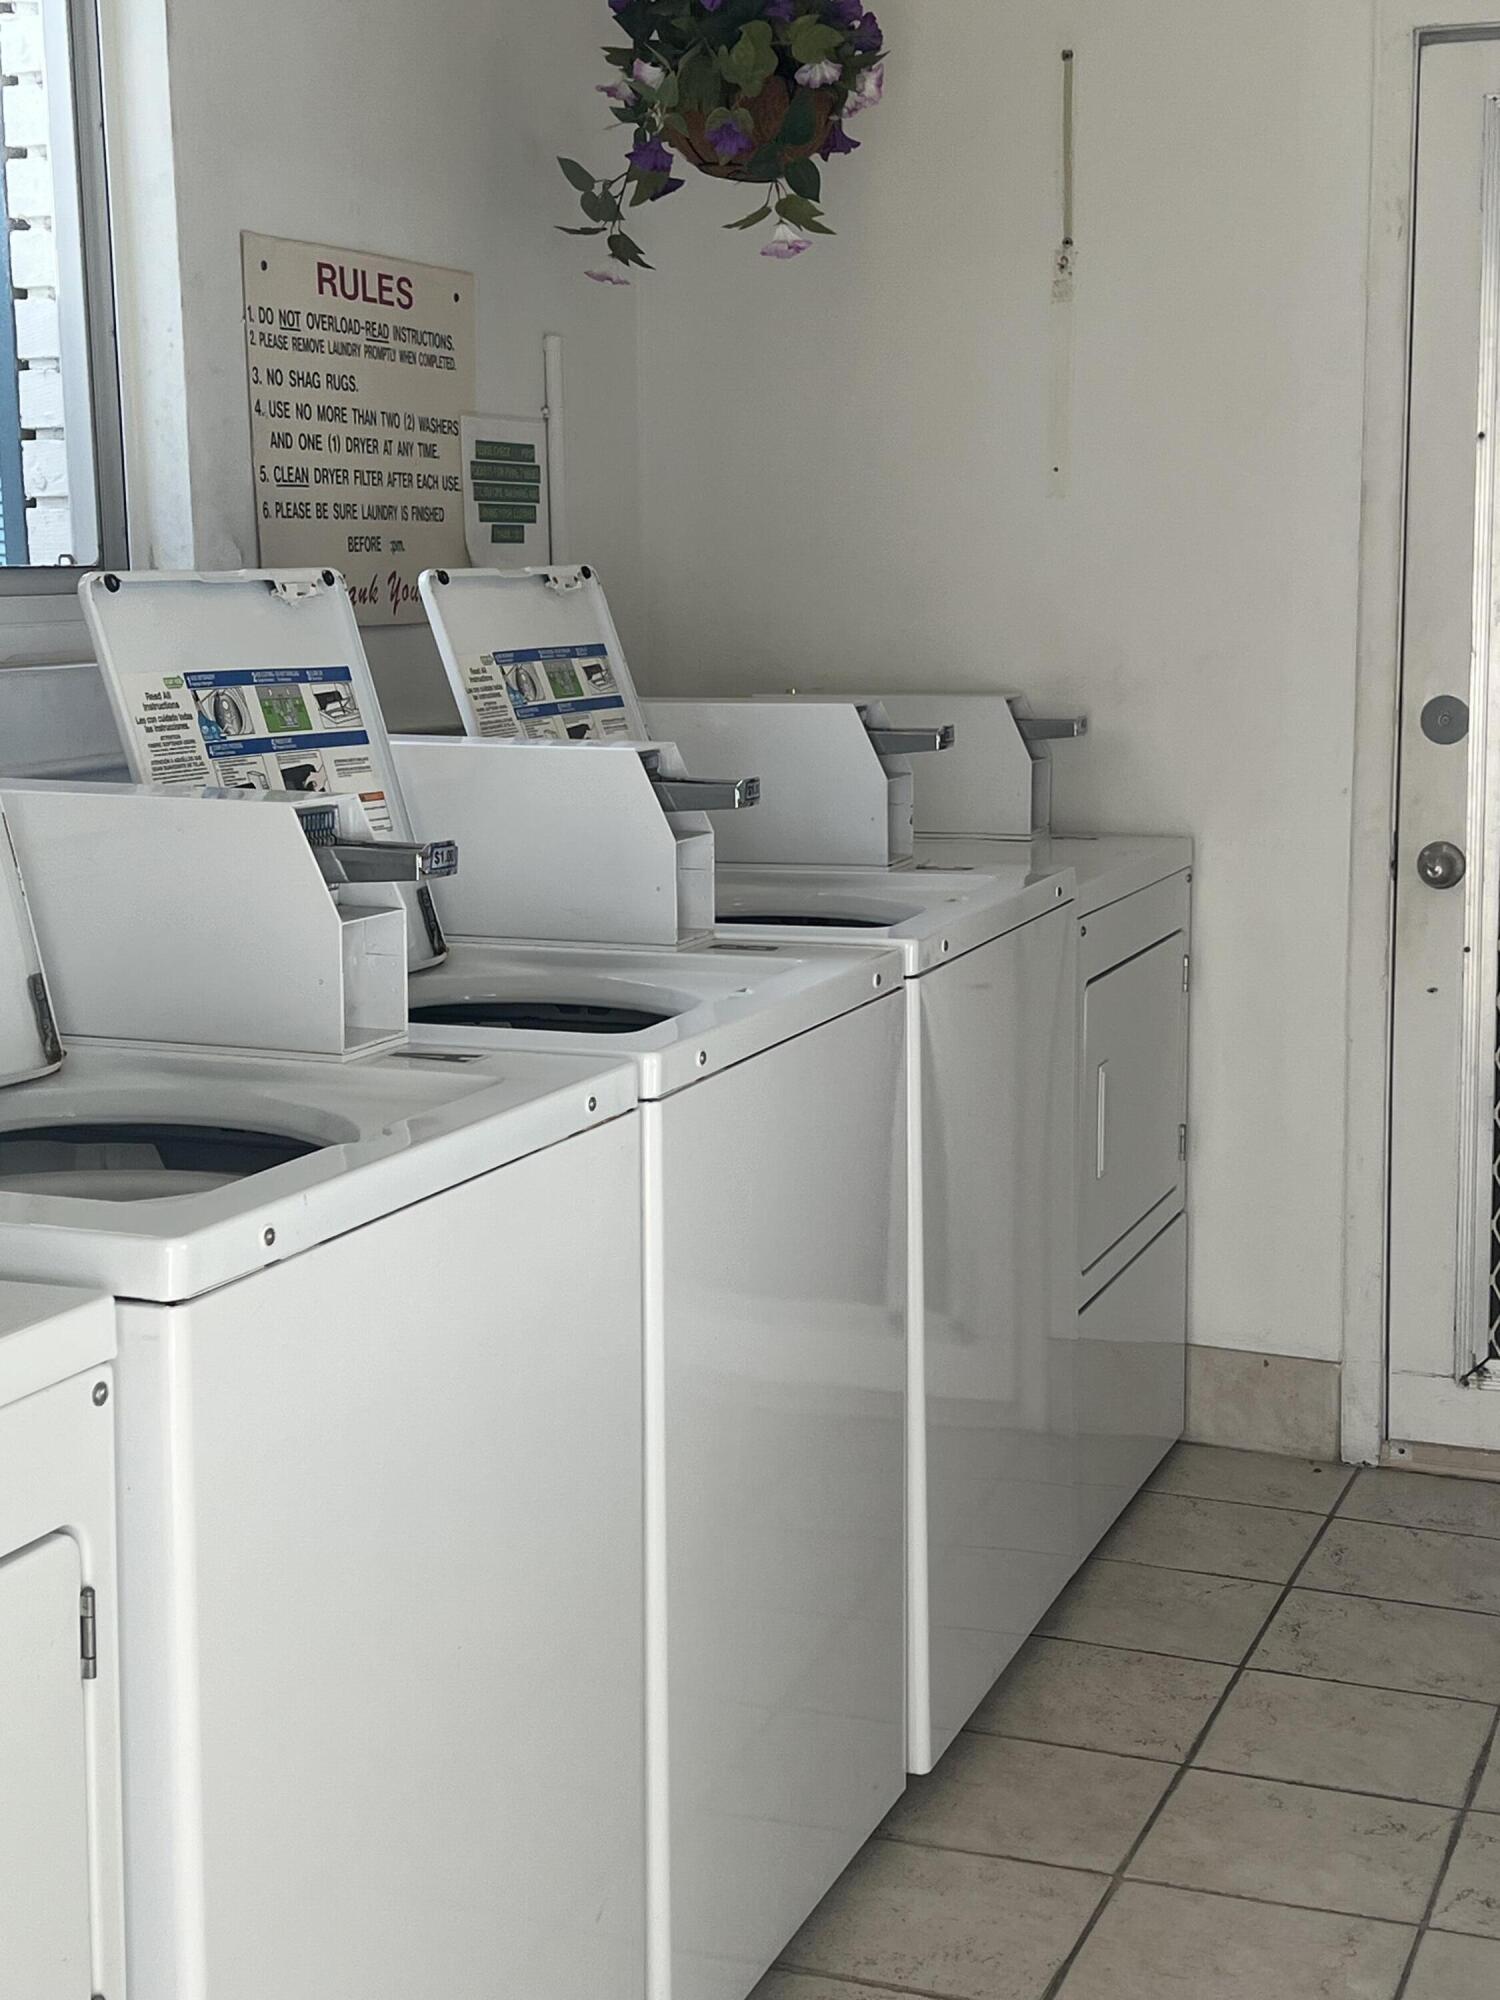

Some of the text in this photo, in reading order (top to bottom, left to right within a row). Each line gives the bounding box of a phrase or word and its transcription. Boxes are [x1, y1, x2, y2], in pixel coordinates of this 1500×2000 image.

[317, 262, 413, 310] RULES
[247, 306, 455, 351] 1. DO NOT OVERLOAD-READ INSTRUCTIONS.
[259, 332, 289, 350] PLEASE
[292, 334, 325, 354] REMOVE
[327, 340, 361, 358] LAUNDRY
[364, 344, 396, 362] PROMPTLY
[400, 350, 417, 366] WHEN
[418, 353, 457, 371] COMPLETED.
[252, 366, 359, 392] 3. NO SHAG RUGS.
[254, 398, 460, 436] 4. USE NO MORE THAN TWO (2) WASHERS
[270, 432, 440, 460] AND ONE (1) DRYER AT ANY TIME.
[260, 465, 462, 492] 5. CLEAN DRYER FILTER AFTER EACH USE.
[262, 502, 445, 523] 6. PLEASE BE SURE LAUNDRY IS FINISHED
[348, 536, 382, 552] BEFORE
[348, 573, 380, 606] ank
